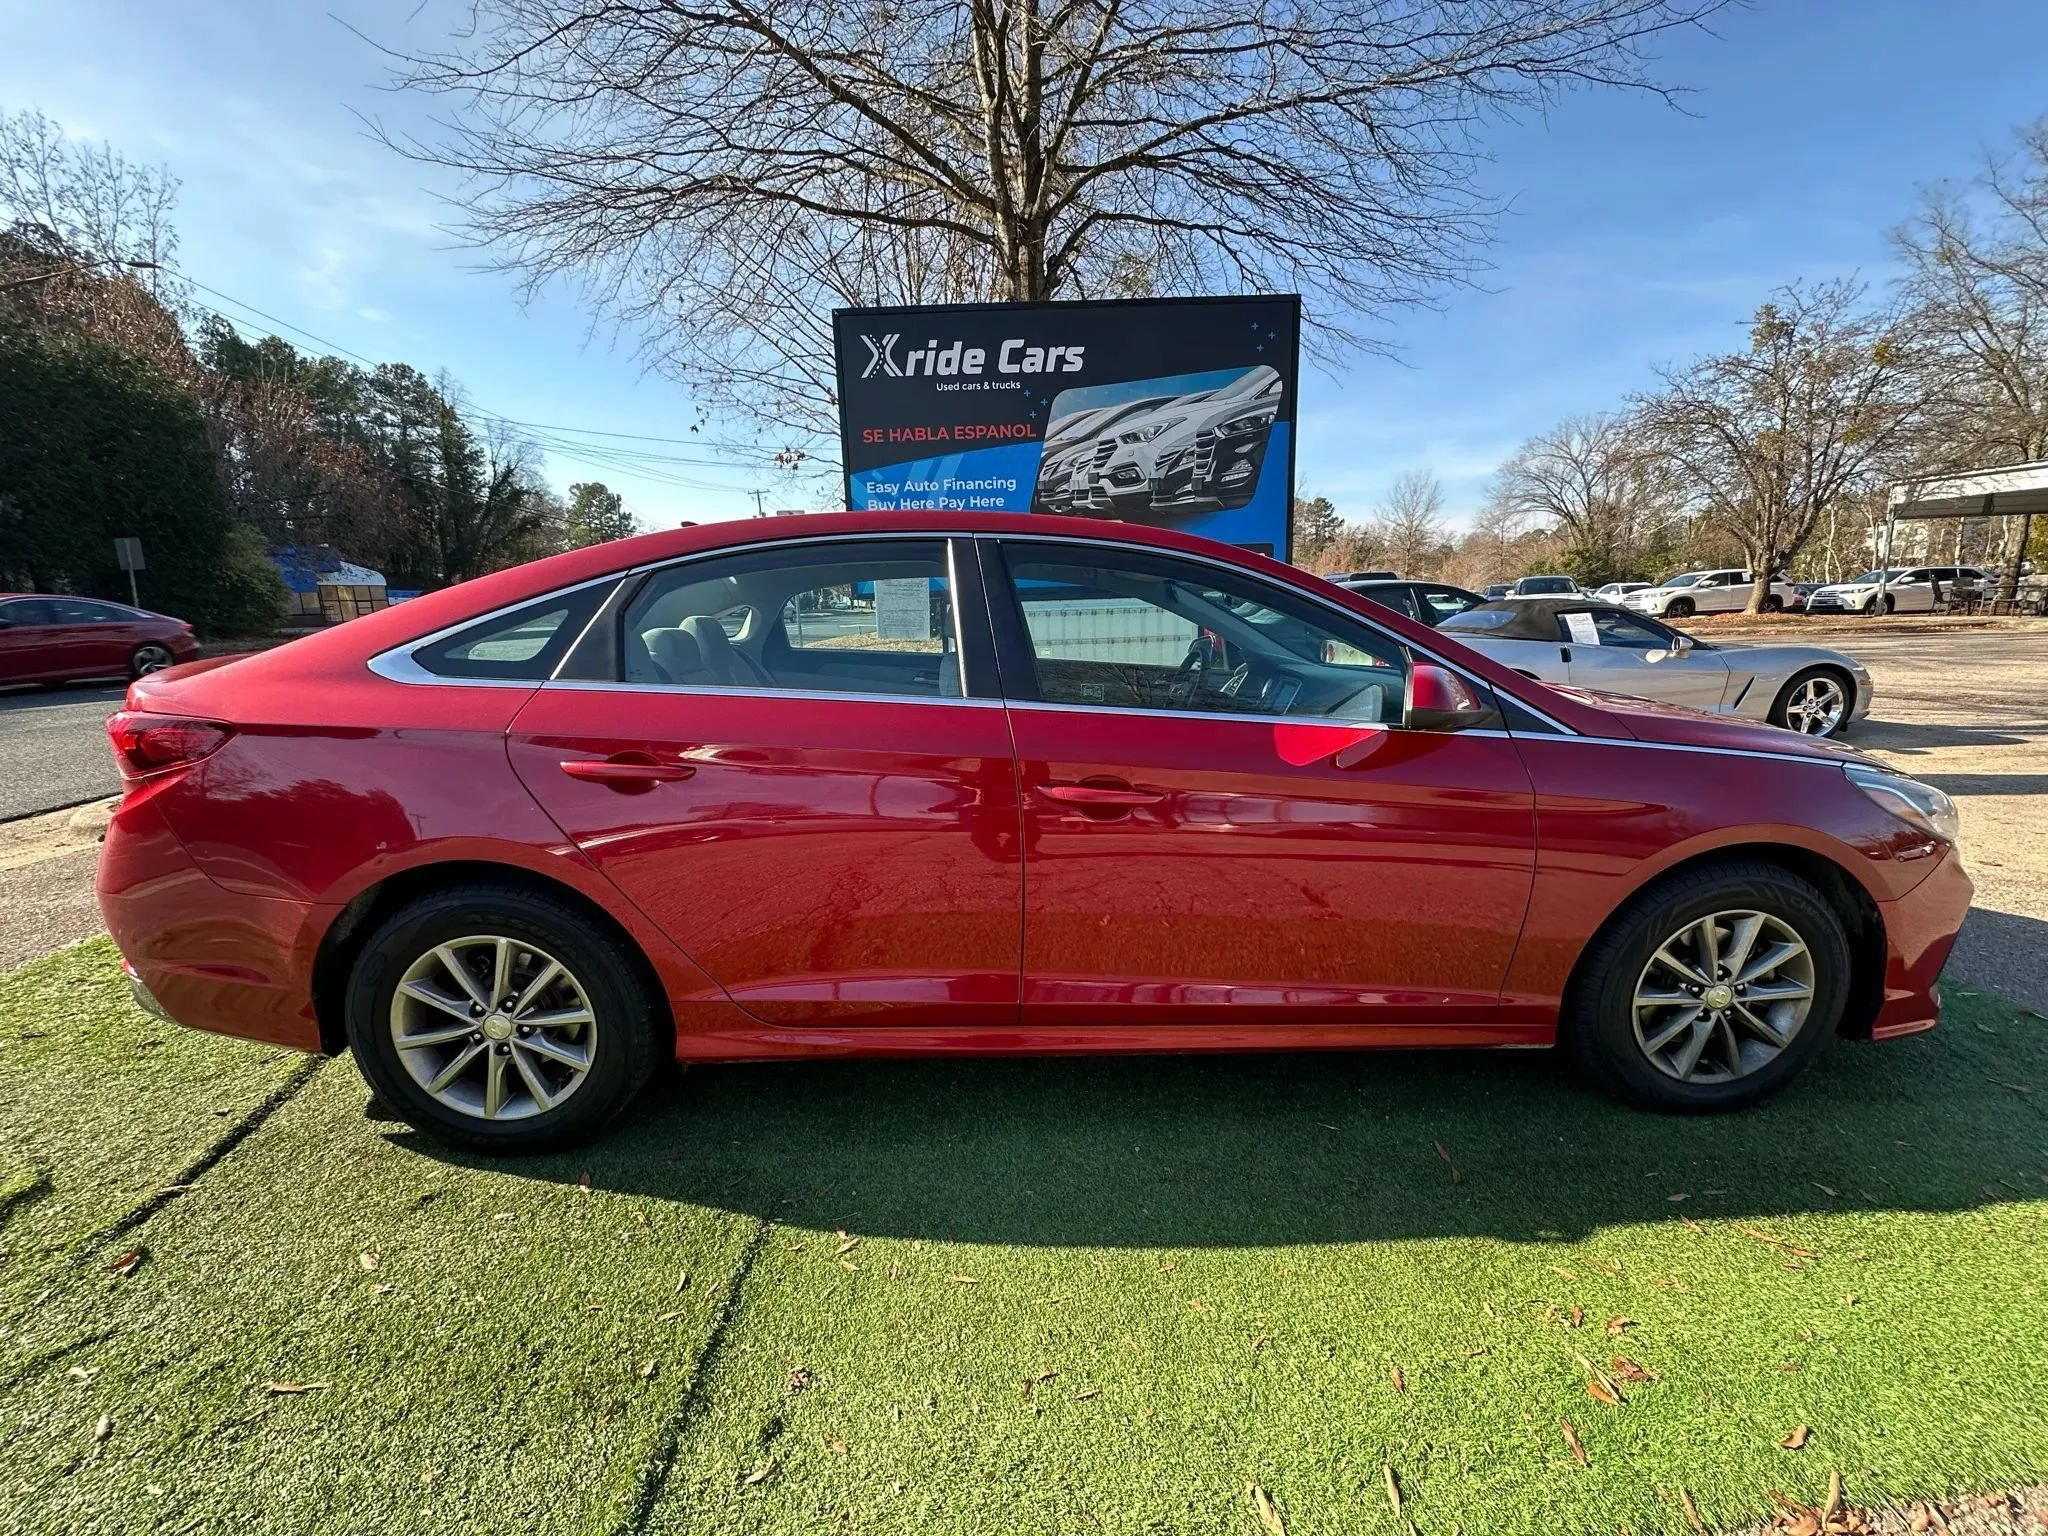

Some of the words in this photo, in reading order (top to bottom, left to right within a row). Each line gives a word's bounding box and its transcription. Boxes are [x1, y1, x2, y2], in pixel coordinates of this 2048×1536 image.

[998, 339, 1085, 374] Cars
[936, 382, 960, 391] Used
[983, 382, 990, 390] &
[992, 381, 1021, 389] trucks
[863, 429, 884, 443] SE
[889, 426, 949, 442] HABLA
[954, 424, 1036, 440] ESPANOL
[867, 482, 900, 495] Easy
[904, 480, 938, 492] Auto
[943, 477, 1016, 491] Financing
[868, 499, 896, 511] Buy
[900, 498, 934, 510] Here
[939, 497, 964, 511] Pay
[970, 496, 1005, 507] Here
